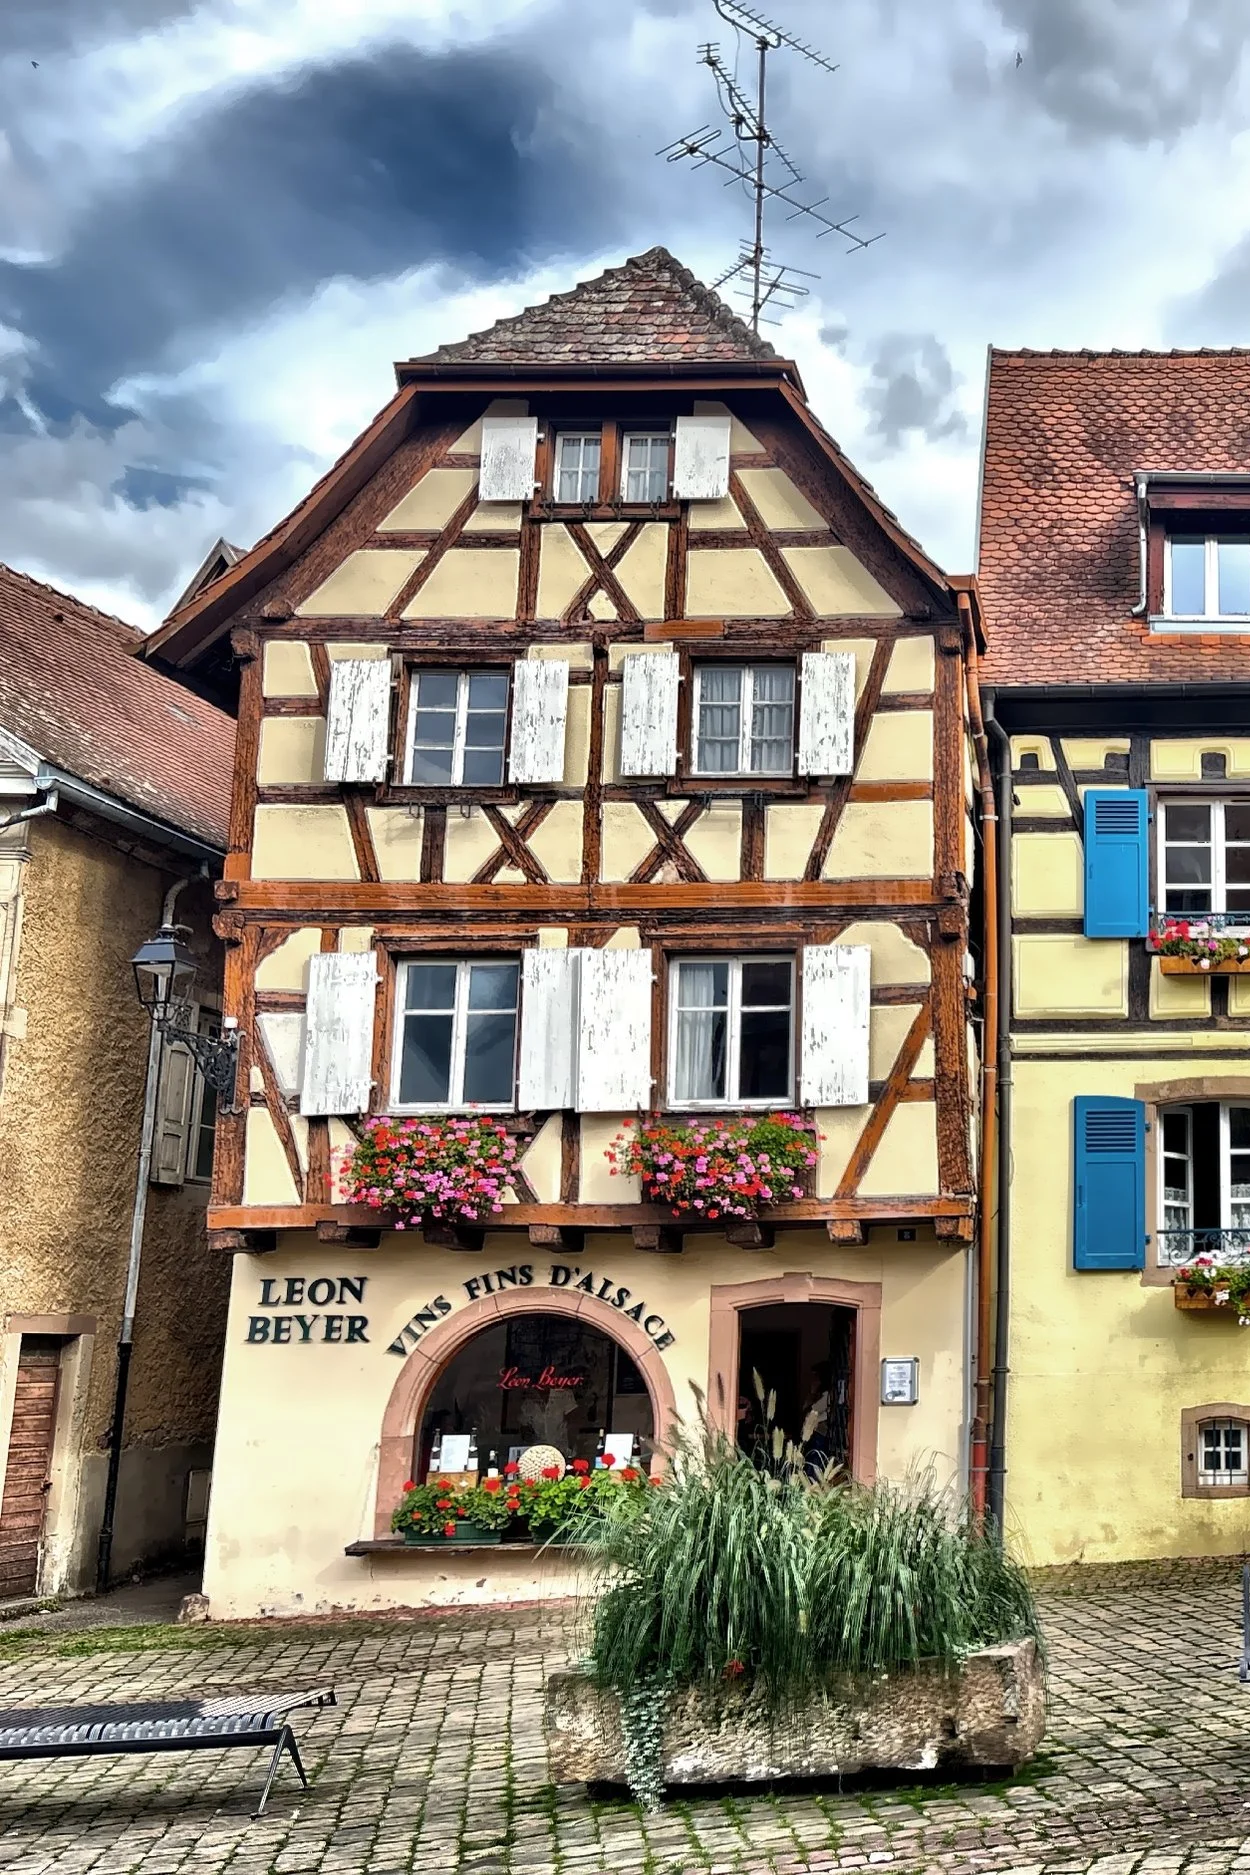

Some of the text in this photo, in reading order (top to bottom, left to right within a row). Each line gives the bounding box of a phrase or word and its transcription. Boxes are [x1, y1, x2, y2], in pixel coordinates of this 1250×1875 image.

[259, 1276, 369, 1306] LEON
[386, 1263, 677, 1356] VINS FINS D'ALSACE
[247, 1315, 370, 1345] BEYER
